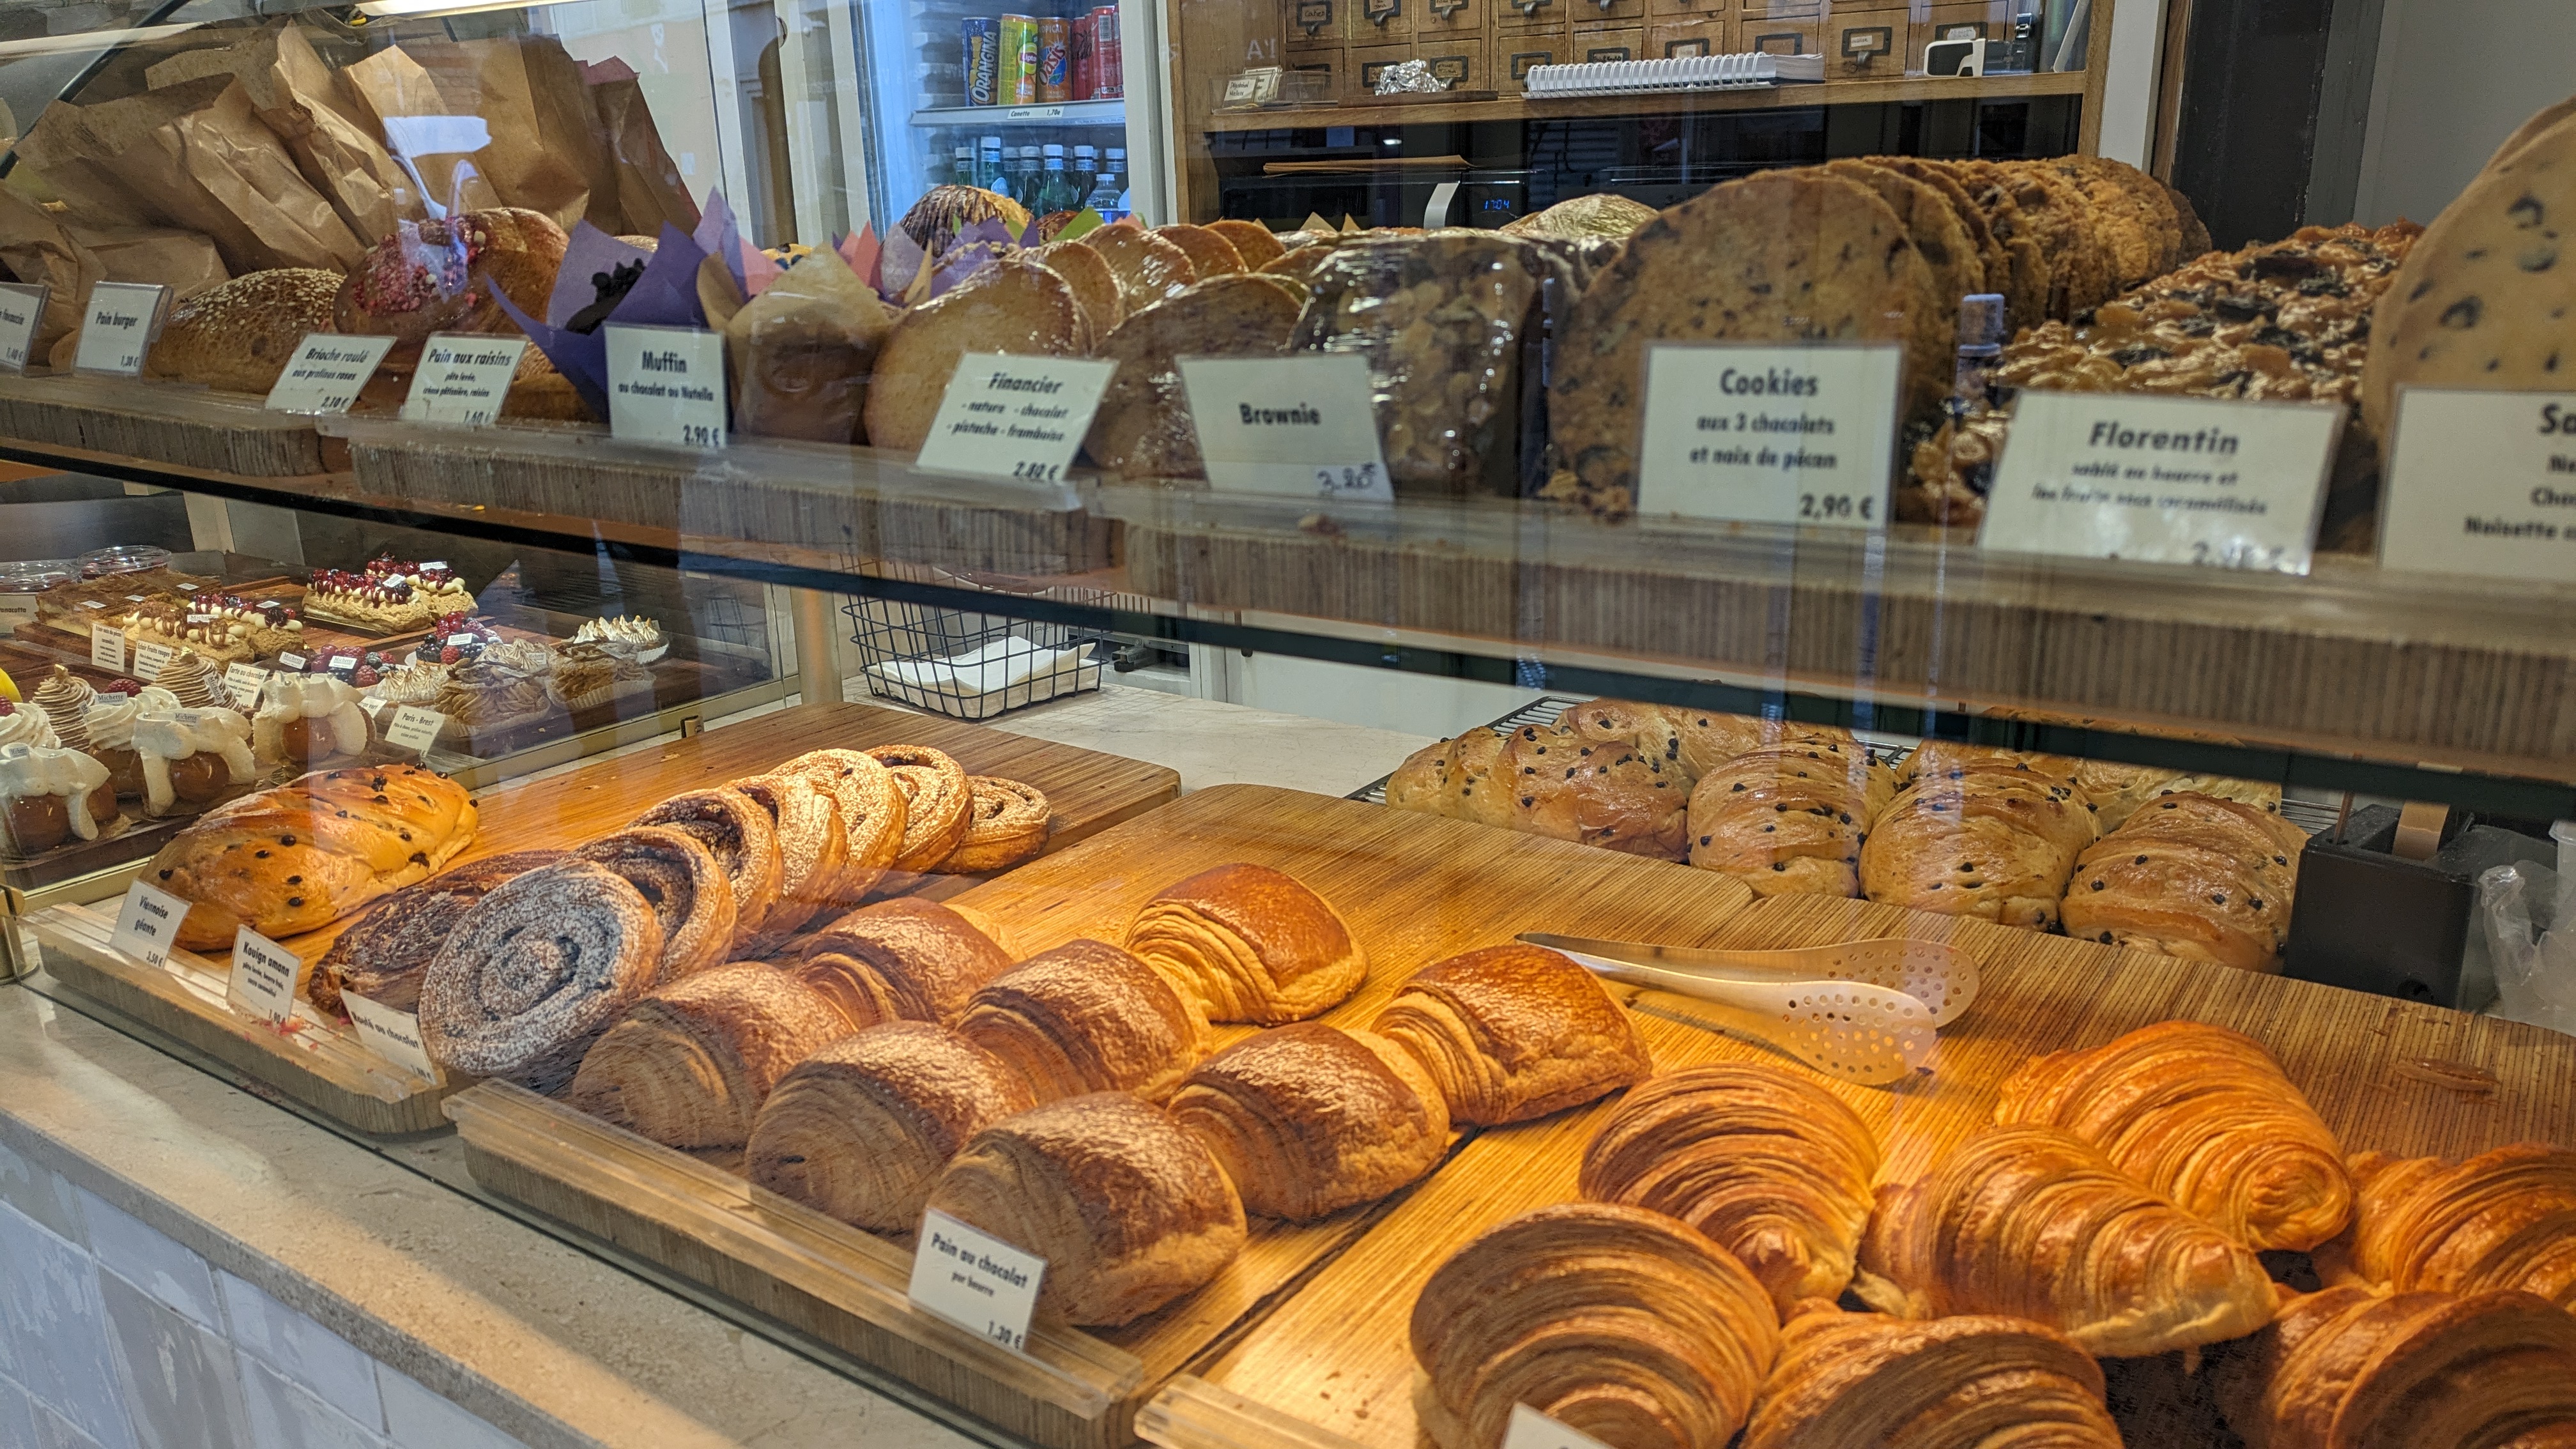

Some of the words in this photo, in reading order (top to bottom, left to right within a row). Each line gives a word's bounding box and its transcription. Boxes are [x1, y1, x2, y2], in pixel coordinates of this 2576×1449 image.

[1040, 25, 1062, 33] OPICAL
[971, 32, 997, 103] ORANGINA
[1039, 46, 1066, 86] Oasis
[1485, 199, 1510, 210] 17:04
[96, 312, 112, 325] Pain
[112, 312, 137, 330] burger
[305, 348, 341, 360] Brioche
[341, 351, 369, 363] roulé
[427, 349, 451, 363] Pain
[453, 353, 473, 364] aux
[474, 351, 512, 366] raisins
[642, 351, 687, 373] Muffin
[304, 368, 336, 380] pralines
[445, 372, 458, 382] pâte
[988, 371, 1063, 394] Financier
[1720, 367, 1819, 395] Cookies
[470, 388, 489, 397] raisins
[631, 381, 666, 396] chocolat
[681, 385, 714, 401] Nutella
[968, 401, 1006, 414] nature
[1020, 402, 1068, 418] chocolat
[1239, 402, 1321, 425] Brownie
[951, 420, 998, 436] pistache
[1007, 424, 1064, 441] framboise
[1696, 416, 1728, 431] aux
[1736, 413, 1746, 432] 3
[1751, 413, 1835, 434] chocolats
[2090, 422, 2240, 455] Florentin
[1690, 447, 1708, 464] et
[1712, 447, 1751, 466] noix
[1757, 447, 1778, 467] de
[1782, 448, 1837, 472] pécan
[2073, 462, 2119, 478] sablé
[2152, 464, 2211, 484] beurre
[2217, 471, 2239, 486] et
[1859, 494, 1874, 519] €
[2465, 516, 2557, 540] Noisette
[147, 645, 157, 654] Fruits
[158, 650, 170, 658] rouges
[284, 653, 303, 663] Michette
[229, 666, 240, 675] Tarte
[247, 670, 264, 680] chocolat
[210, 676, 222, 701] Michette
[175, 712, 197, 721] Michette
[402, 712, 415, 722] Paris
[419, 716, 434, 726] Brest
[140, 895, 169, 919] Viennoise
[134, 919, 157, 936] géante
[146, 951, 158, 965] 3,50
[158, 958, 164, 967] €
[243, 941, 266, 964] Kouign
[268, 958, 289, 977] amann
[263, 972, 275, 983] beurre
[375, 1024, 385, 1035] au
[387, 1027, 419, 1050] chocolat
[931, 1232, 958, 1257] Pain
[960, 1250, 976, 1265] au
[978, 1254, 1027, 1289] chocolat
[967, 1276, 994, 1298] beurre
[1015, 1333, 1022, 1349] €
